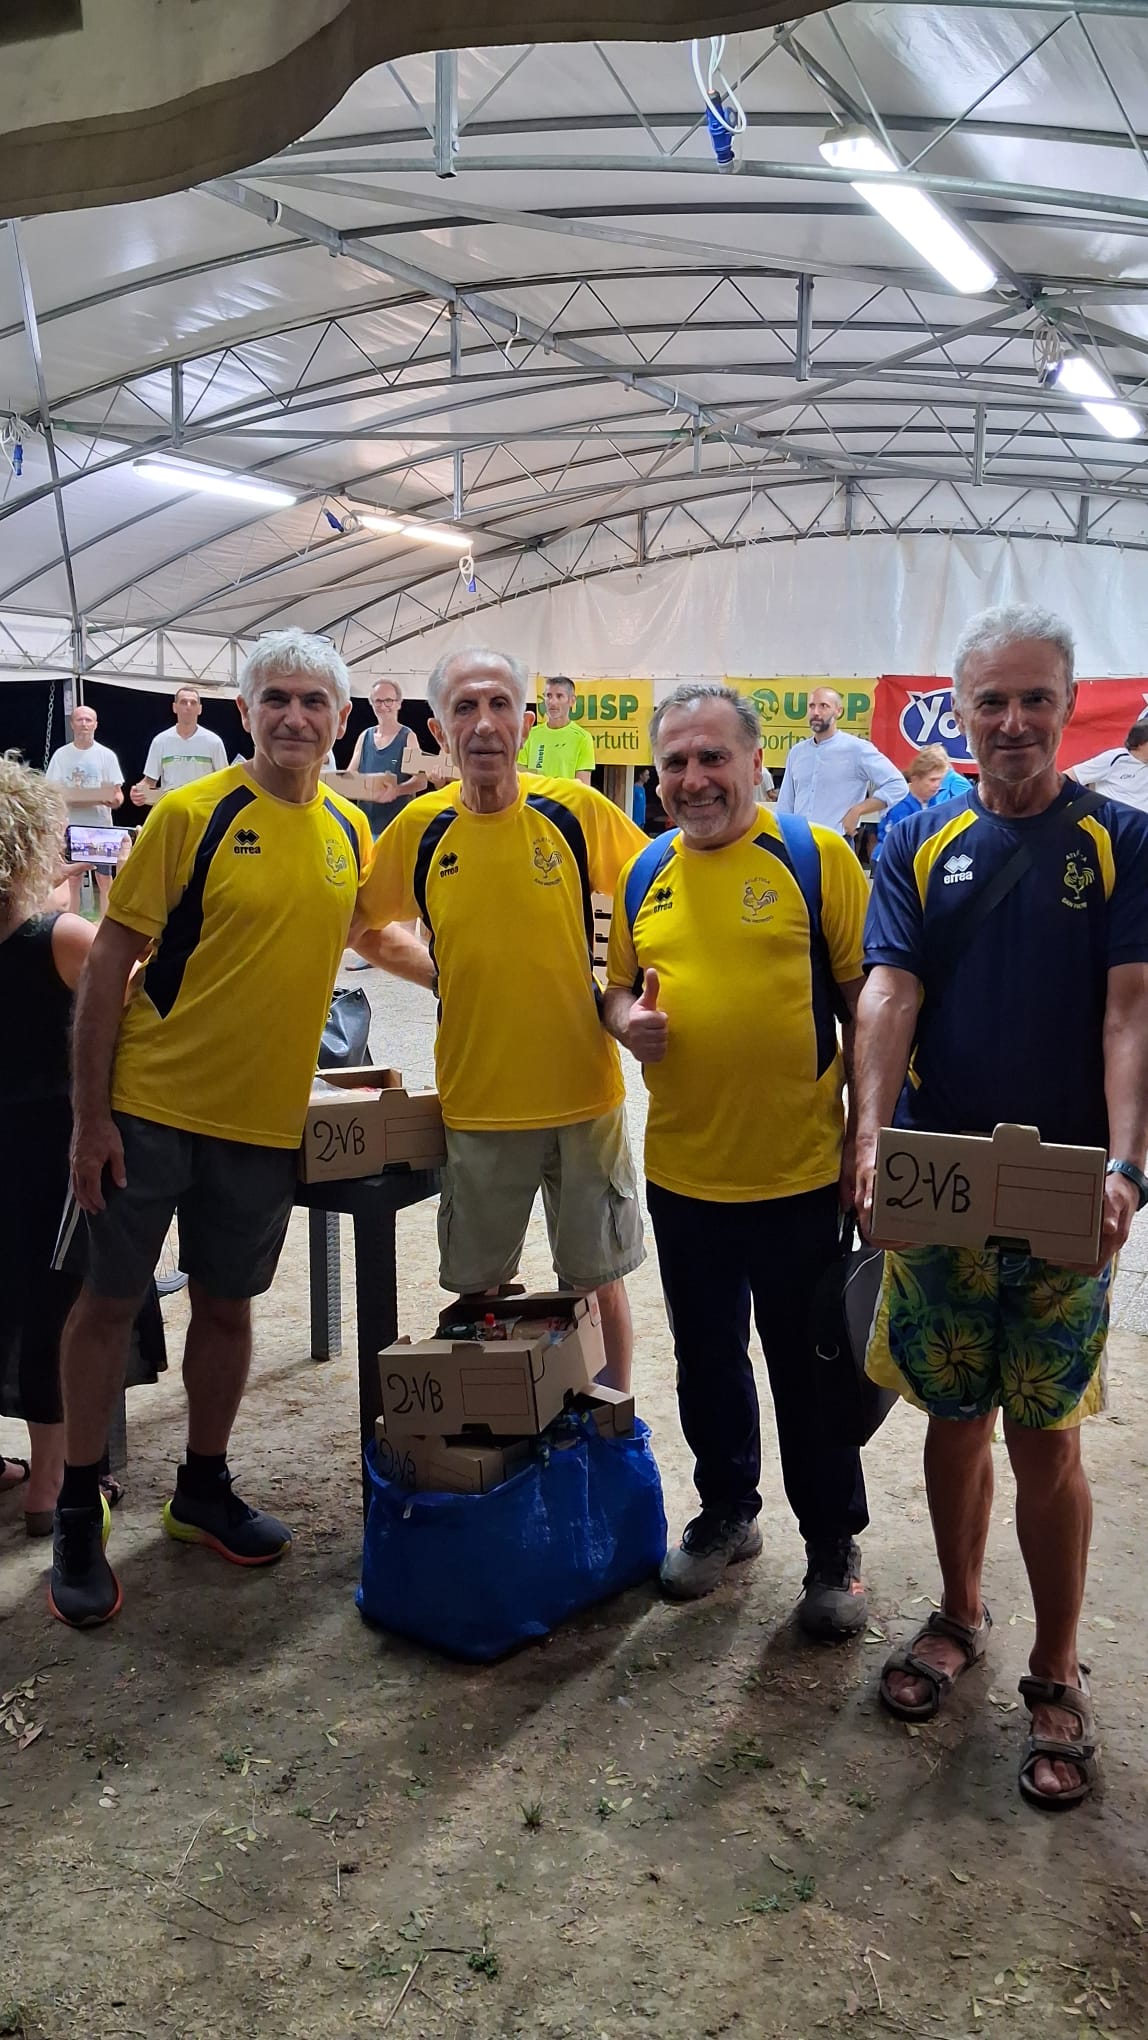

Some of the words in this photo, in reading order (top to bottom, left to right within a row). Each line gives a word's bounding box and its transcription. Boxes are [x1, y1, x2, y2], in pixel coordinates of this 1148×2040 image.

[784, 692, 871, 721] UP
[233, 846, 261, 854] errea
[943, 870, 973, 885] errea
